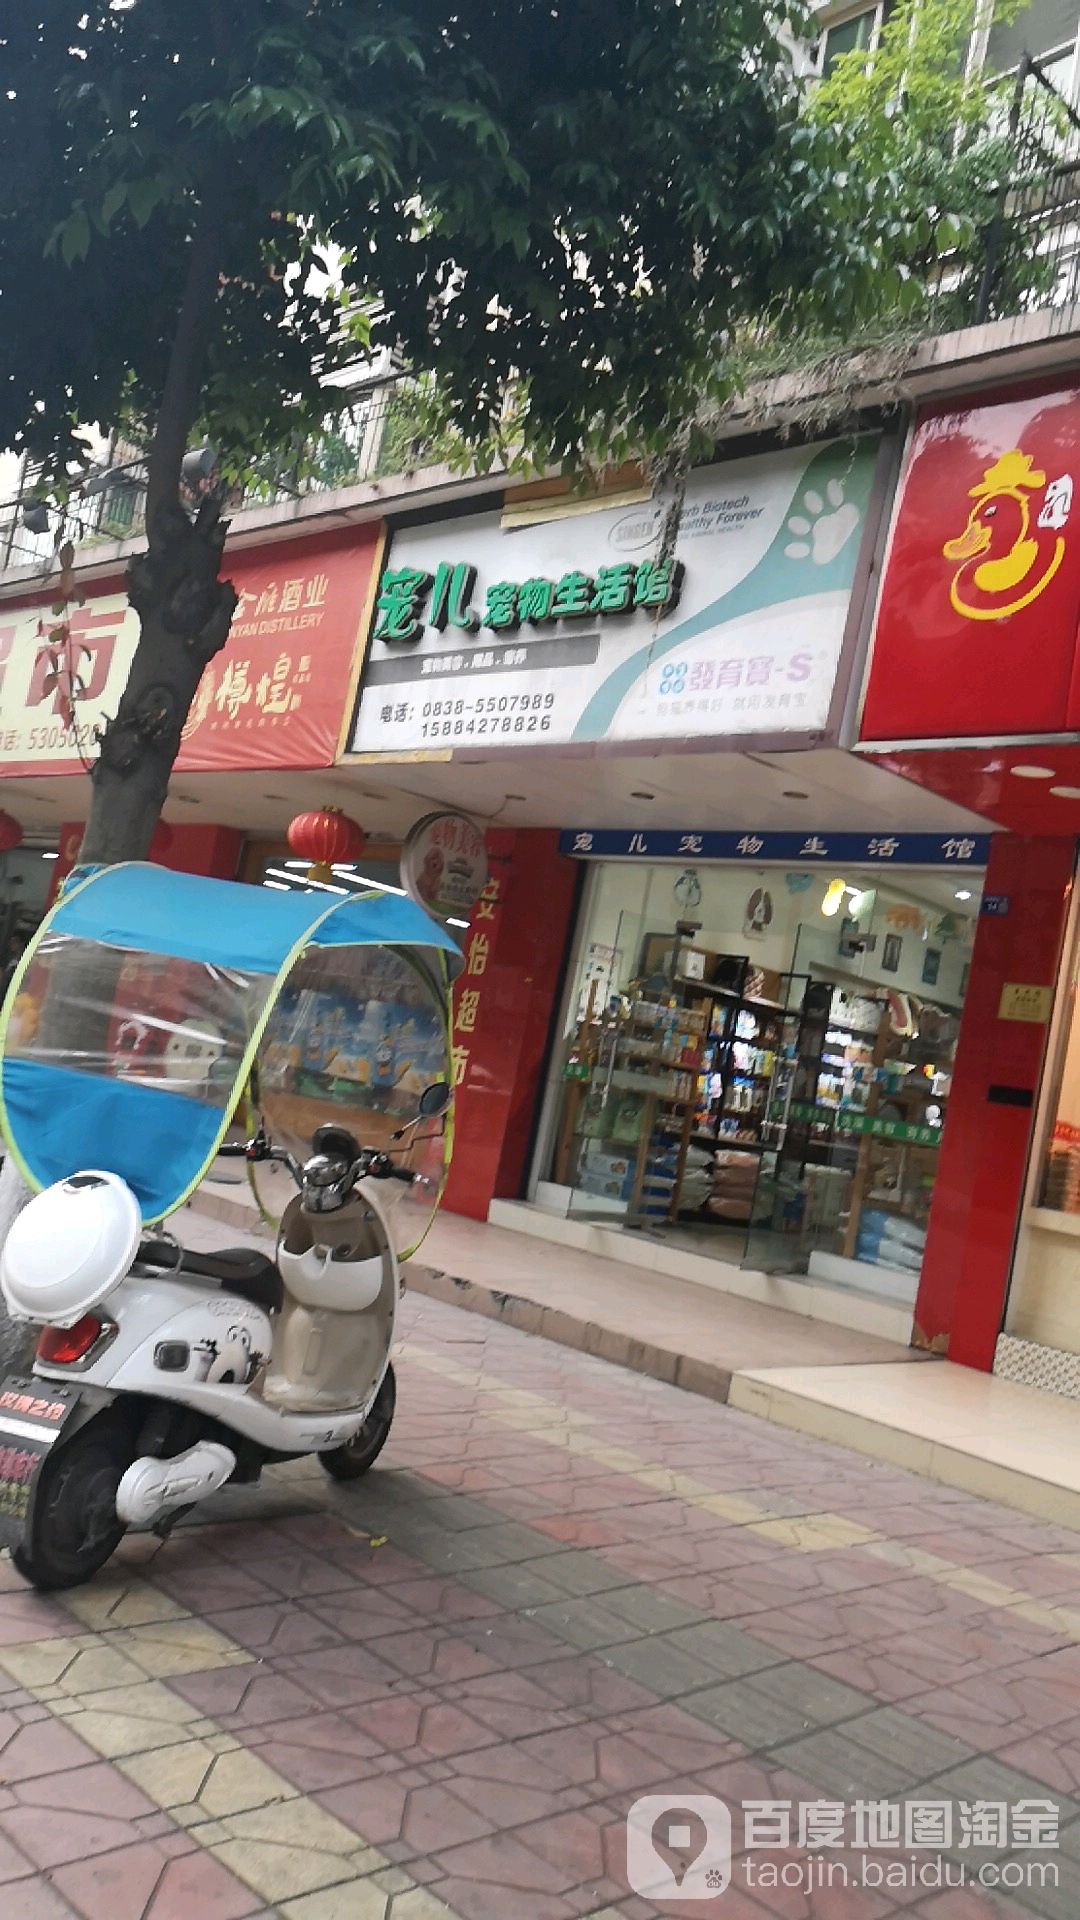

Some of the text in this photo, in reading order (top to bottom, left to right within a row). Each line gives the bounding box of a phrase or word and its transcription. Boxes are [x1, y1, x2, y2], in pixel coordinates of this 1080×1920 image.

[716, 507, 765, 525] Forever
[0, 607, 127, 715] 市
[421, 692, 555, 718] 0838-5507989
[420, 714, 552, 738] 15884278826
